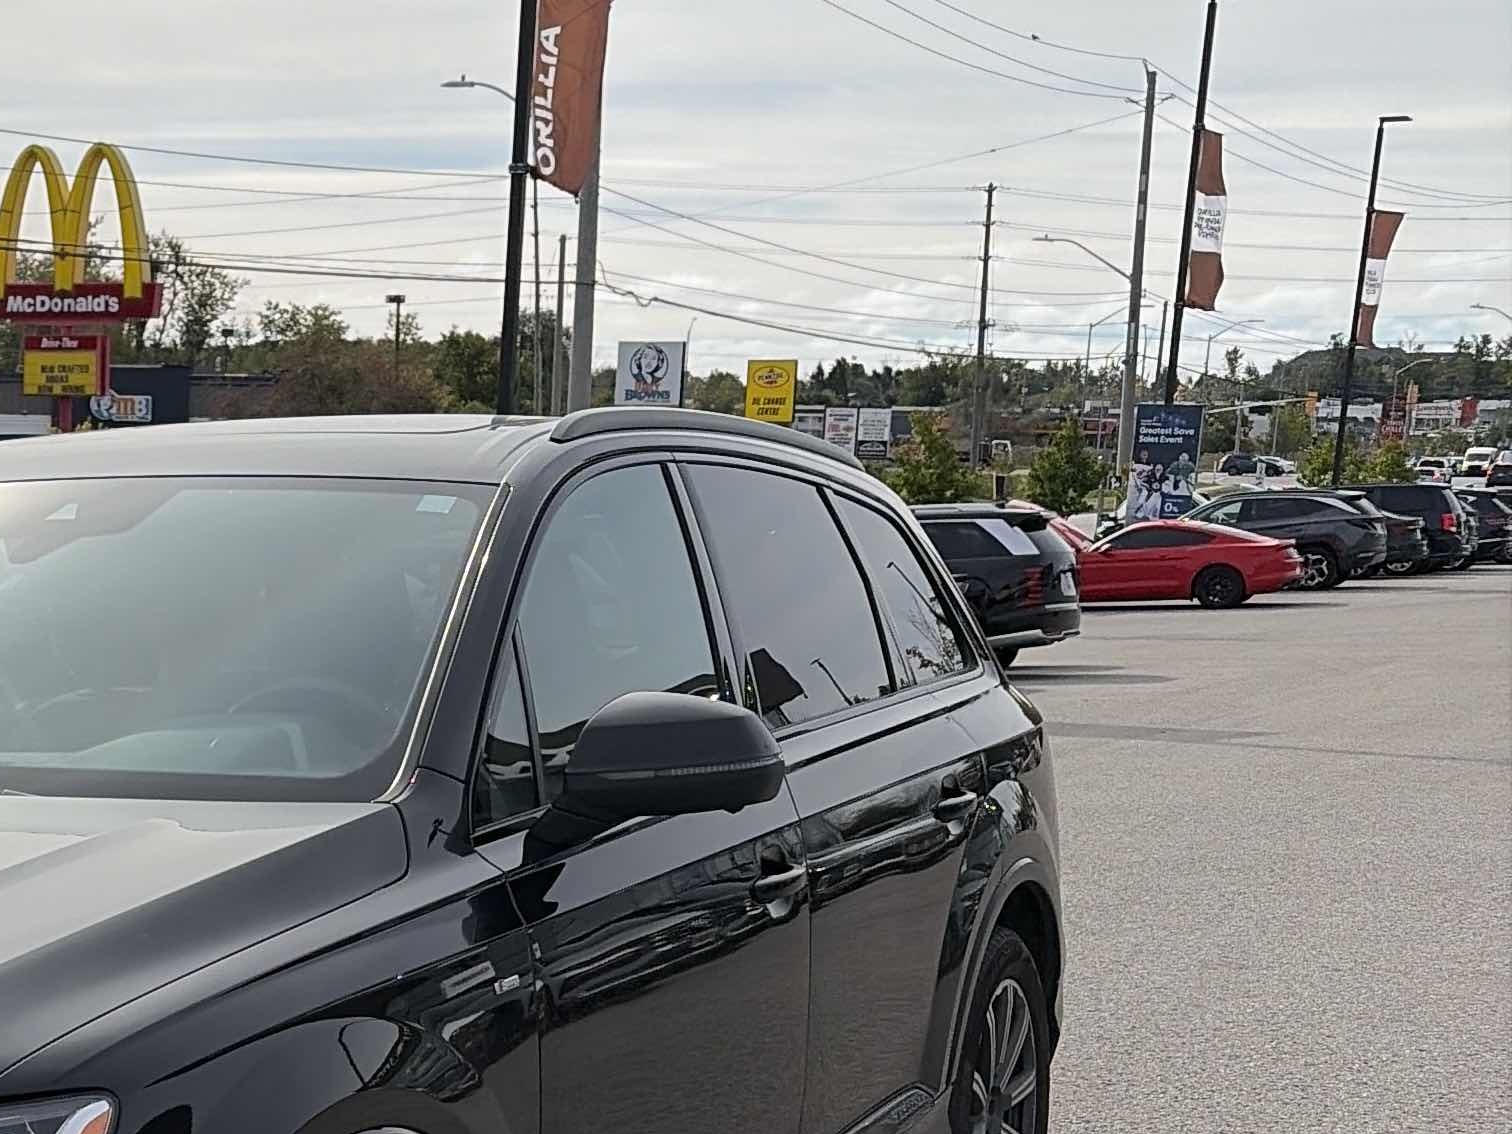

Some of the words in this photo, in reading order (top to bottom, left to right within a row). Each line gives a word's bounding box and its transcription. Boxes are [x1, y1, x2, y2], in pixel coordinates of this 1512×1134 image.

[535, 25, 562, 176] ORILLIA
[7, 295, 119, 312] McDonald's
[1174, 427, 1194, 435] Save
